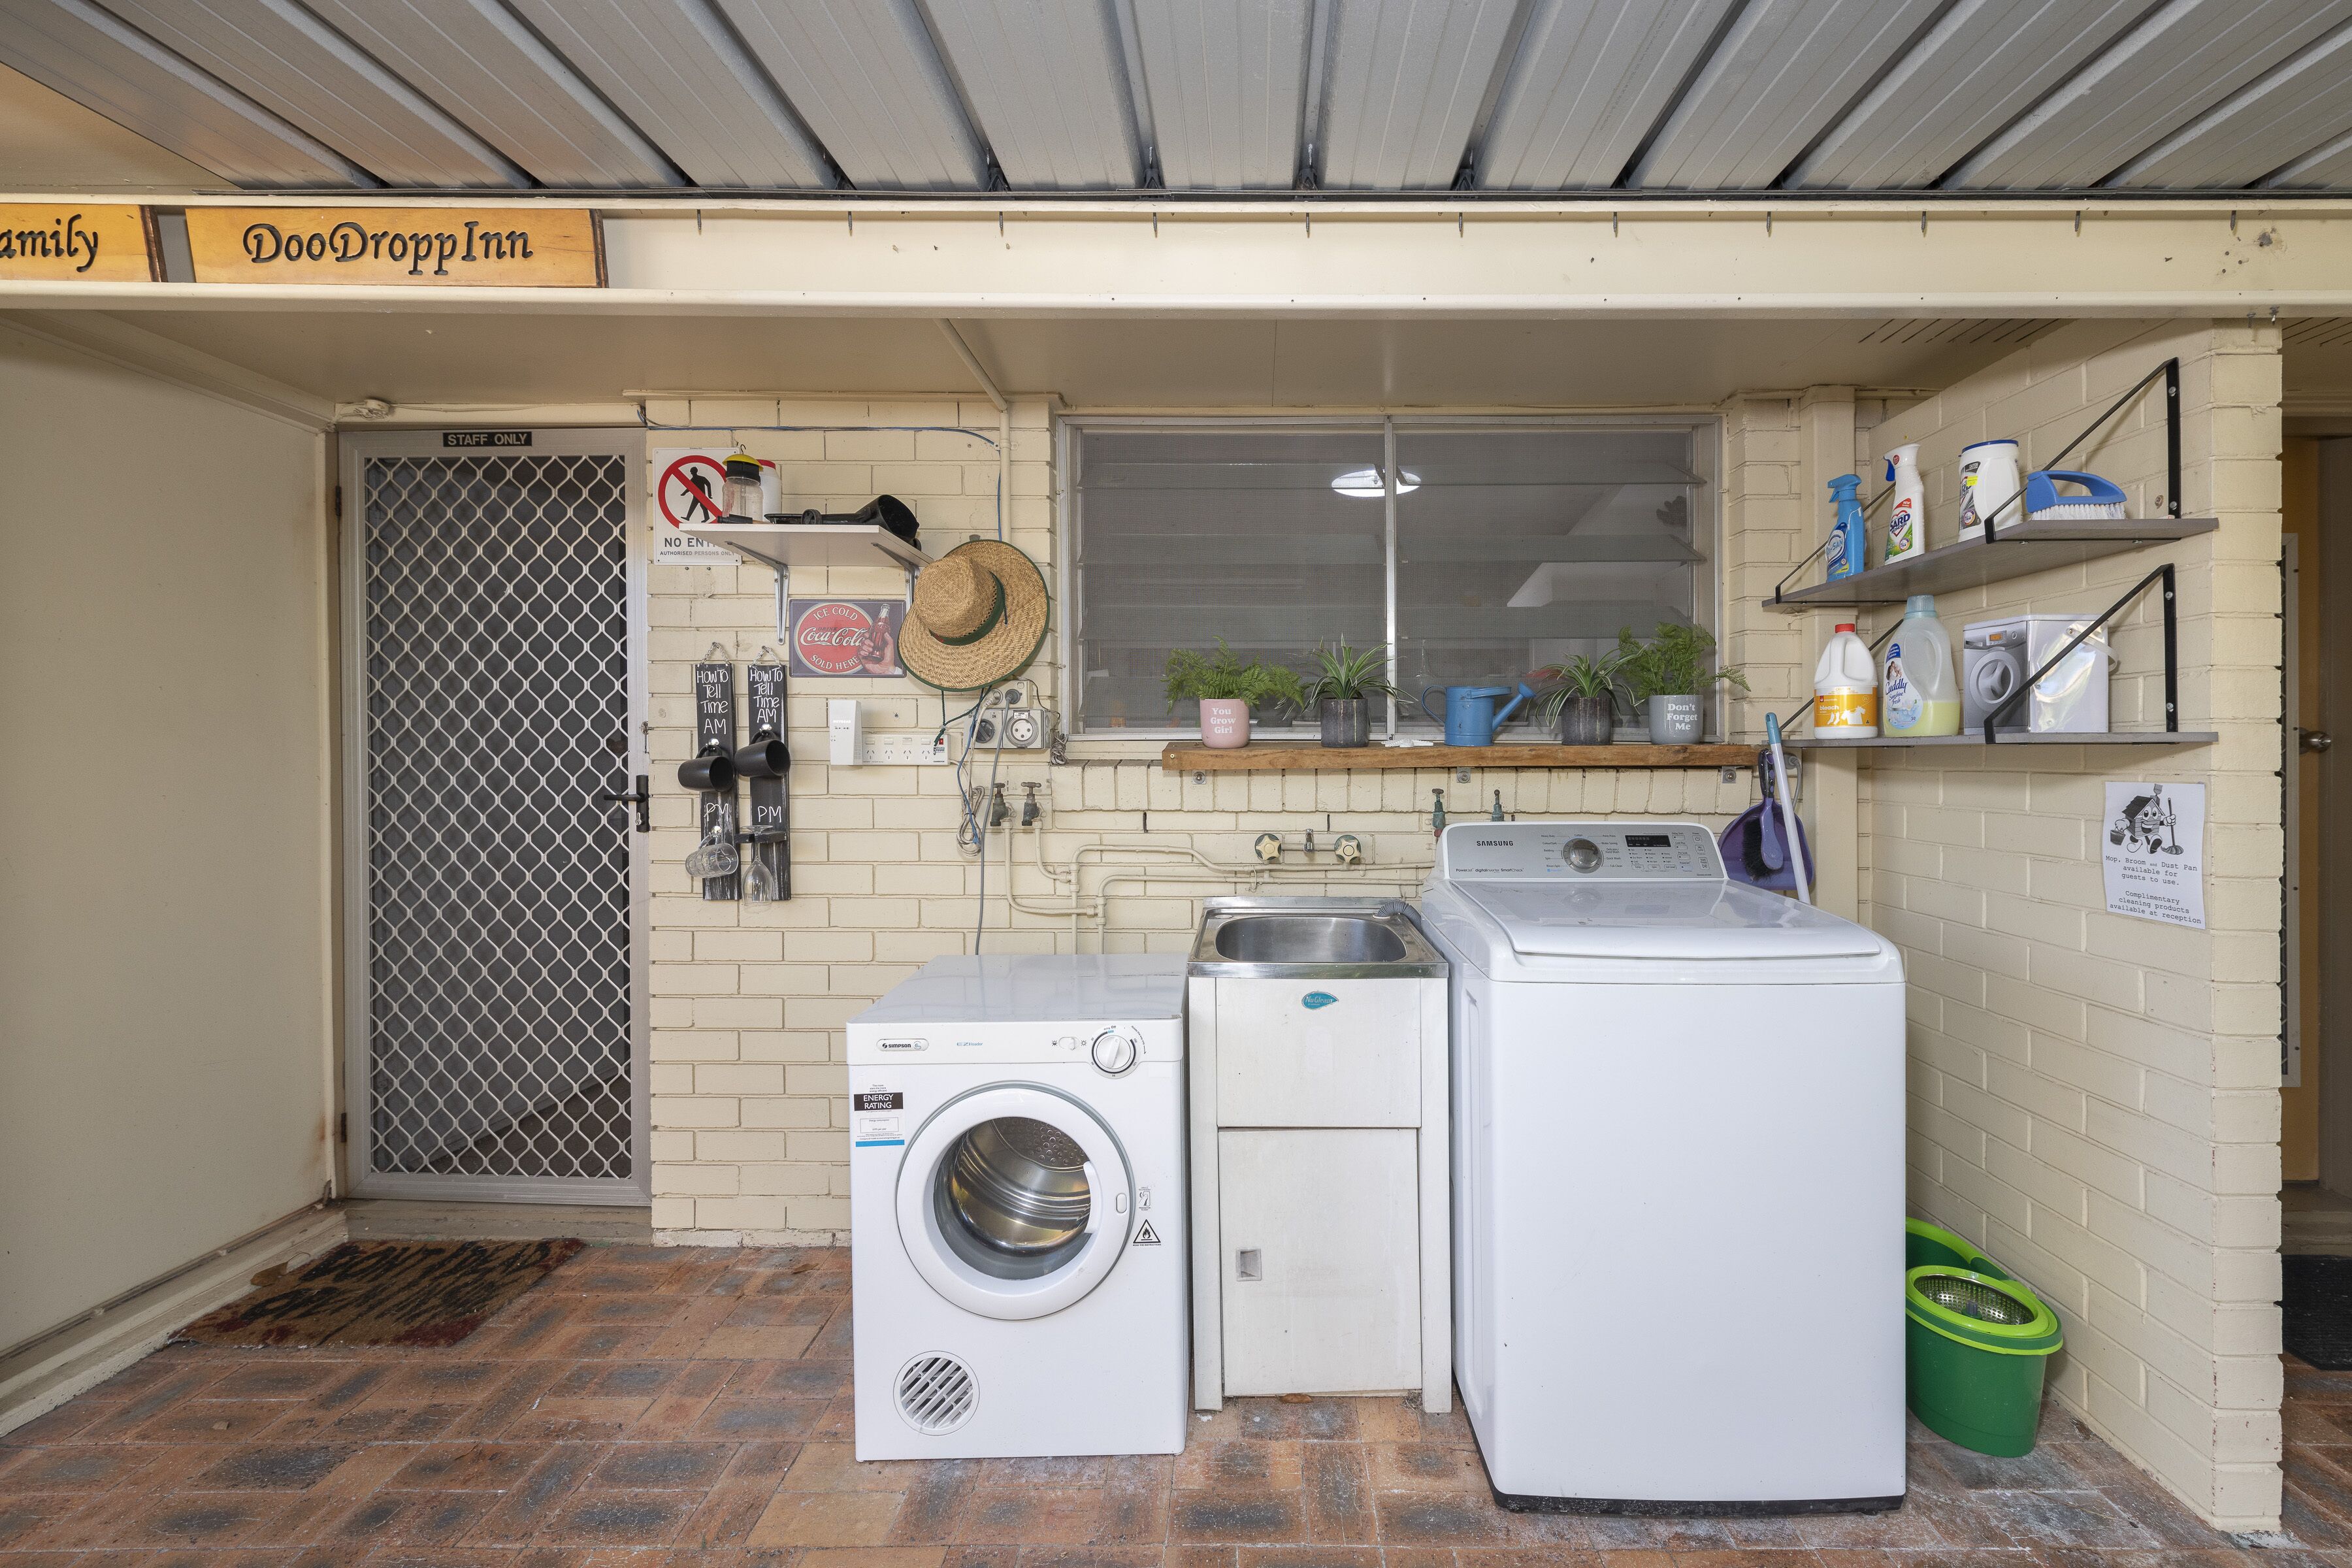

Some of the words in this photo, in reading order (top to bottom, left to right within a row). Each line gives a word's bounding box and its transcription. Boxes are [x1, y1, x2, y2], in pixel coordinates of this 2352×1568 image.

[448, 434, 487, 446] STAFF
[494, 433, 527, 445] ONLY
[1890, 513, 1911, 532] SARD
[664, 538, 681, 547] NO
[813, 608, 830, 621] ICE
[832, 606, 858, 621] COLD
[800, 627, 868, 647] Coca-Cola
[810, 654, 832, 670] SOLD
[836, 655, 860, 670] HERE
[703, 684, 721, 698] Tell
[753, 683, 774, 695] Tell
[1886, 678, 1907, 695] Cuddly
[753, 696, 780, 708] Time
[1889, 691, 1904, 701] Sunshine
[700, 700, 728, 713] Time
[757, 708, 777, 723] AM
[1667, 713, 1697, 723] Forget
[704, 718, 727, 735] AM
[704, 802, 728, 822] PM
[757, 806, 782, 823] PM
[2123, 866, 2160, 875] available
[2119, 897, 2151, 908] cleaning
[2155, 904, 2189, 914] products
[2125, 890, 2180, 906] Complimentary
[2110, 903, 2146, 914] available
[2162, 913, 2201, 924] reception
